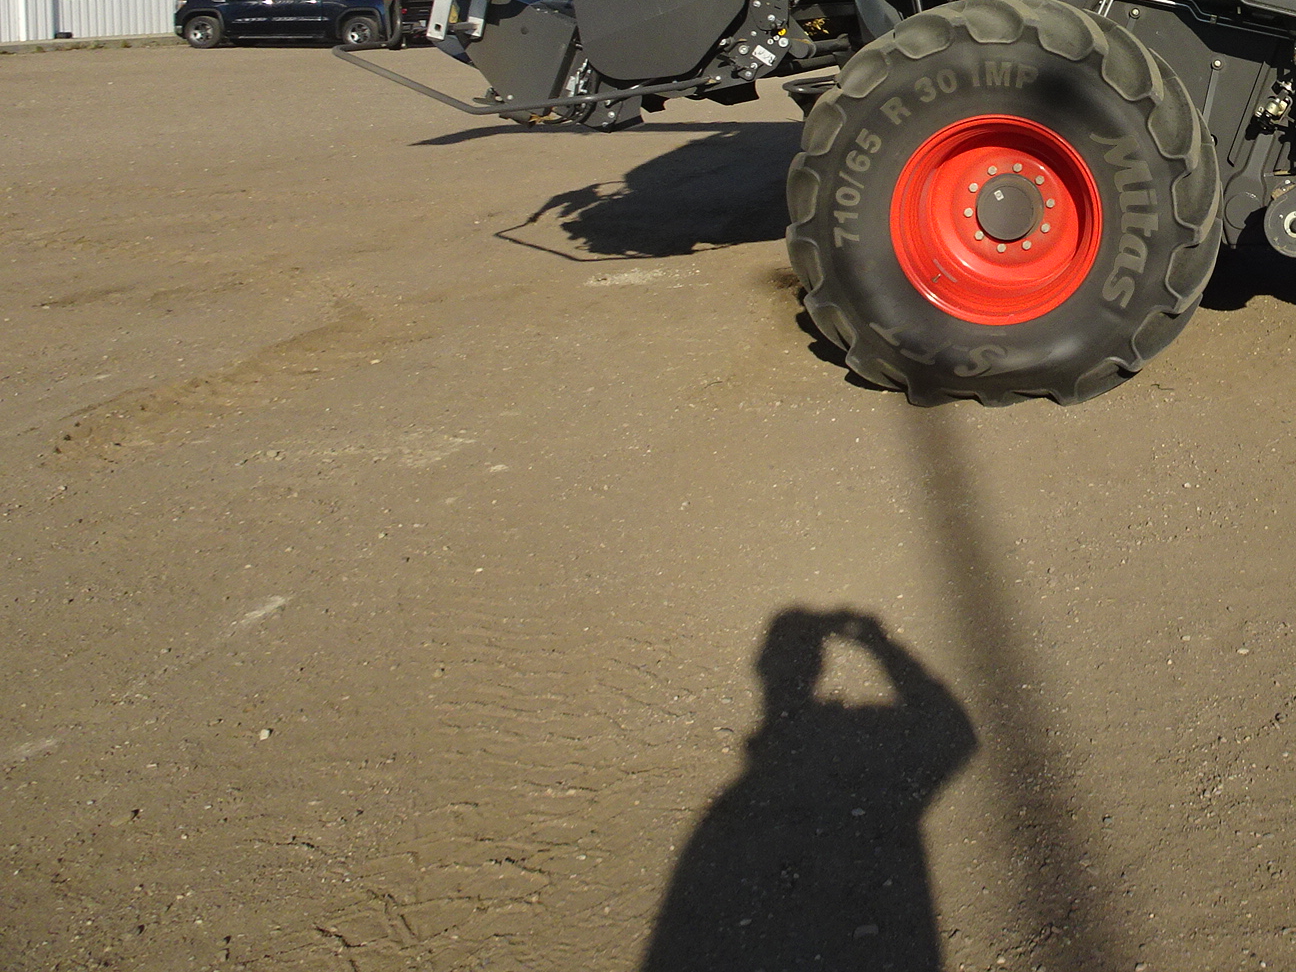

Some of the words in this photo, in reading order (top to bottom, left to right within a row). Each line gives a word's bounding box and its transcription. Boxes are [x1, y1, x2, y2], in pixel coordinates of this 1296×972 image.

[833, 128, 882, 248] 710/65
[880, 96, 912, 125] R
[914, 68, 958, 103] 30
[971, 60, 1039, 89] IMP
[1089, 133, 1158, 309] Mitas
